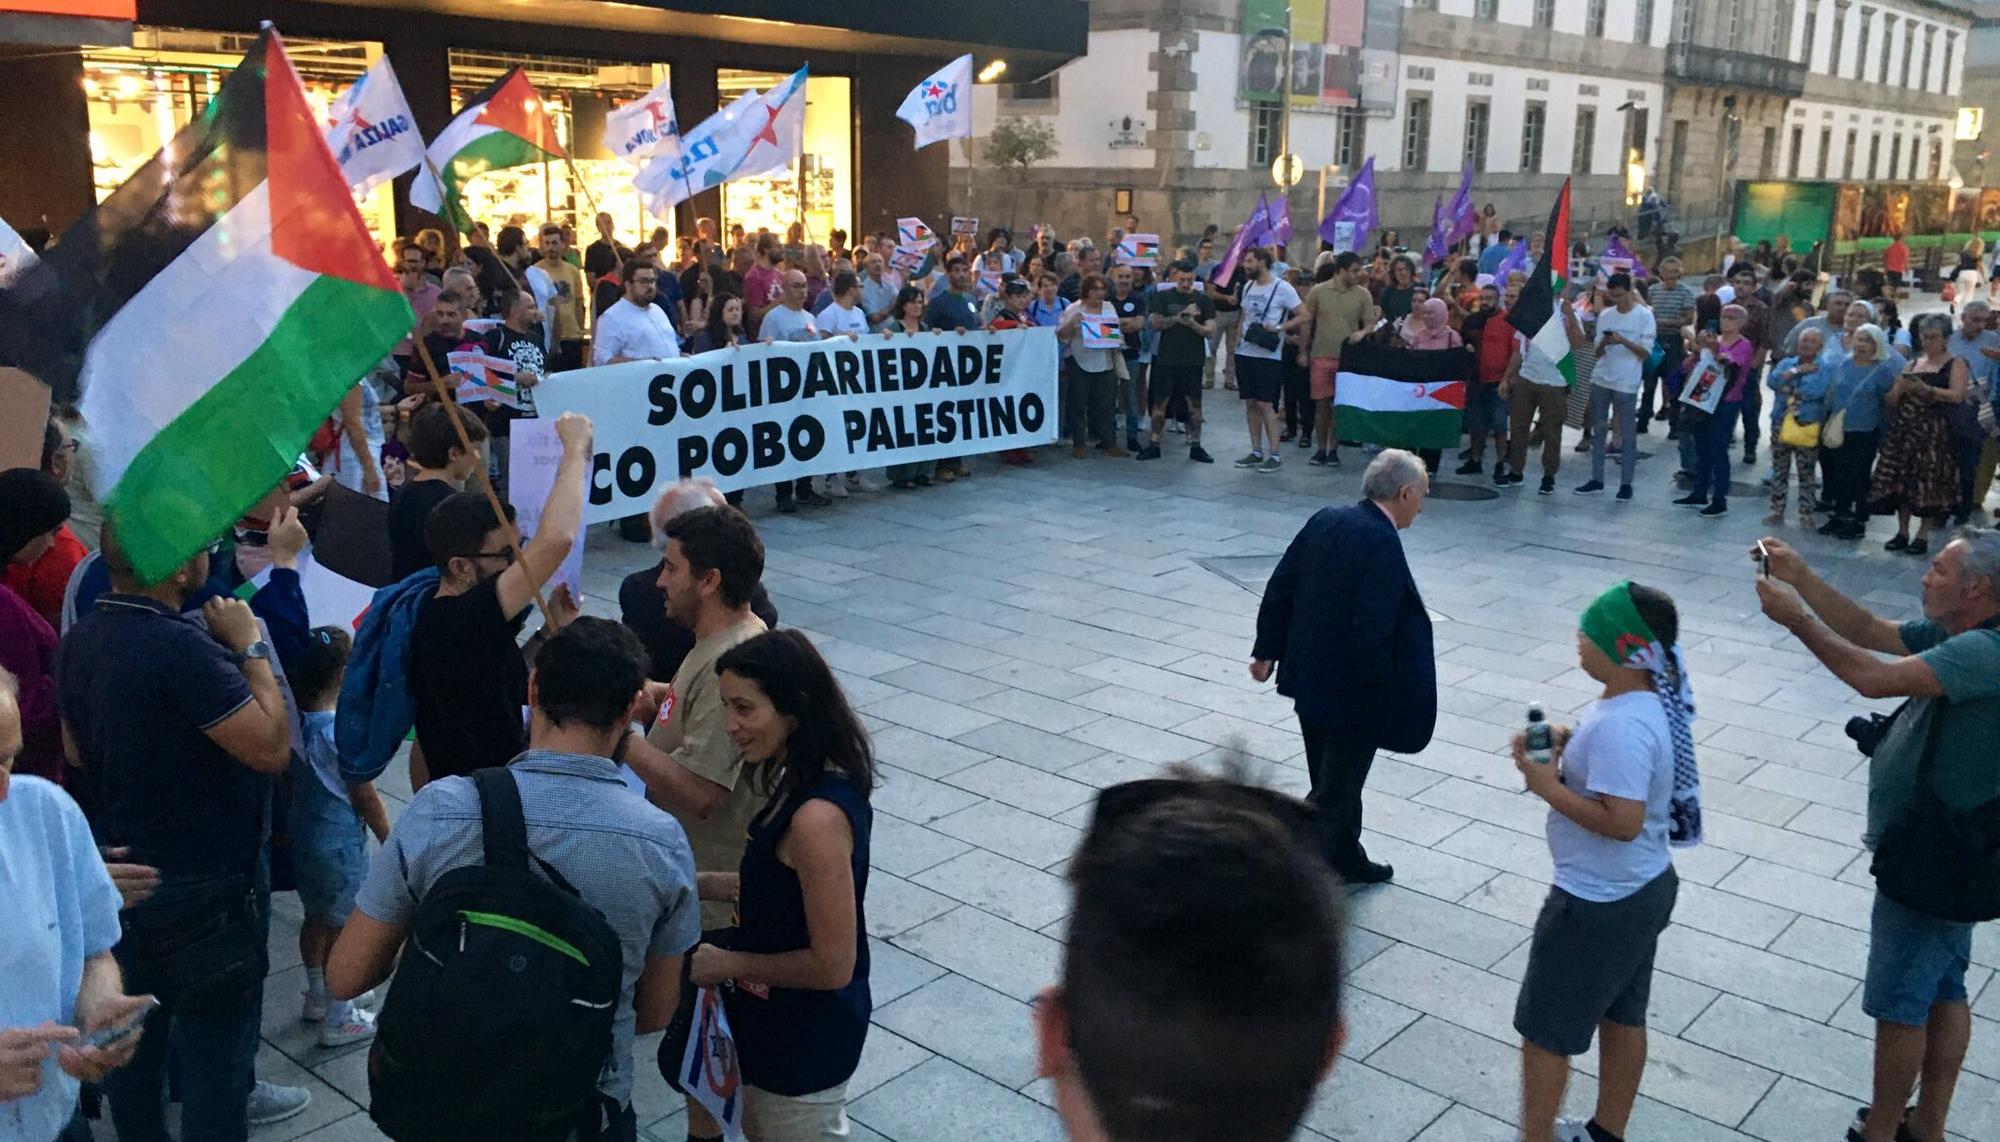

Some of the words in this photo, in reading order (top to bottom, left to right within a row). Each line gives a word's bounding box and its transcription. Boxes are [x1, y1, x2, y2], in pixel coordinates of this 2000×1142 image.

[648, 344, 1004, 427] SOLIDARIEDADE
[588, 446, 657, 507] CO
[678, 414, 826, 481] POBO
[843, 391, 1045, 455] PALESTINO
